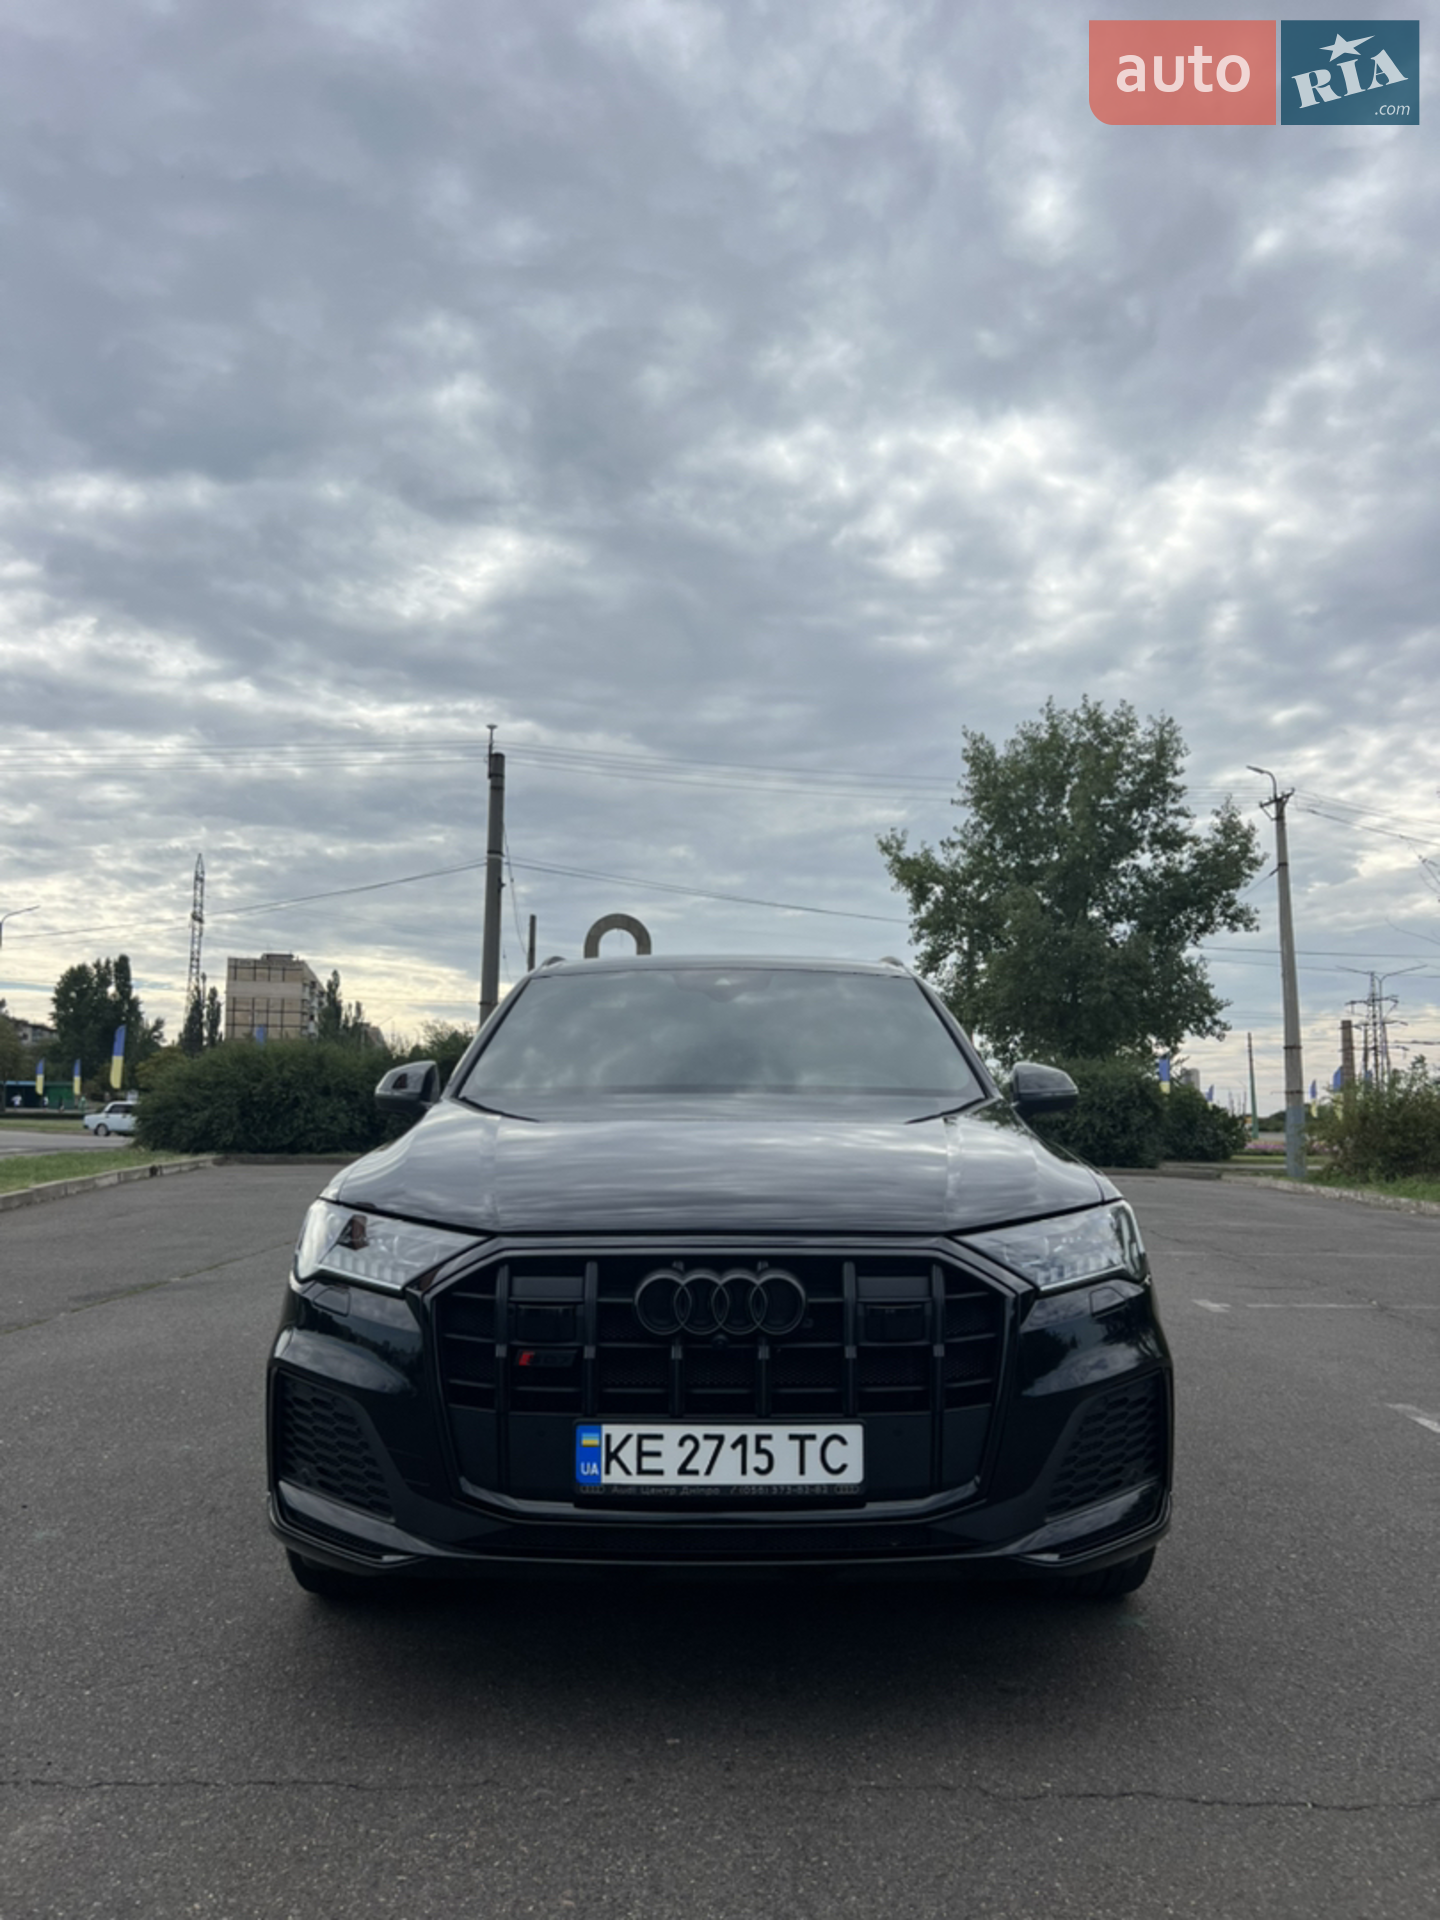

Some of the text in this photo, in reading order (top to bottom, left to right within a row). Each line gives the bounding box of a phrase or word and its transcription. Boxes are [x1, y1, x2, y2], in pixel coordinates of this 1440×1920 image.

[581, 1462, 599, 1475] UA
[604, 1433, 848, 1476] KE 2715 TC
